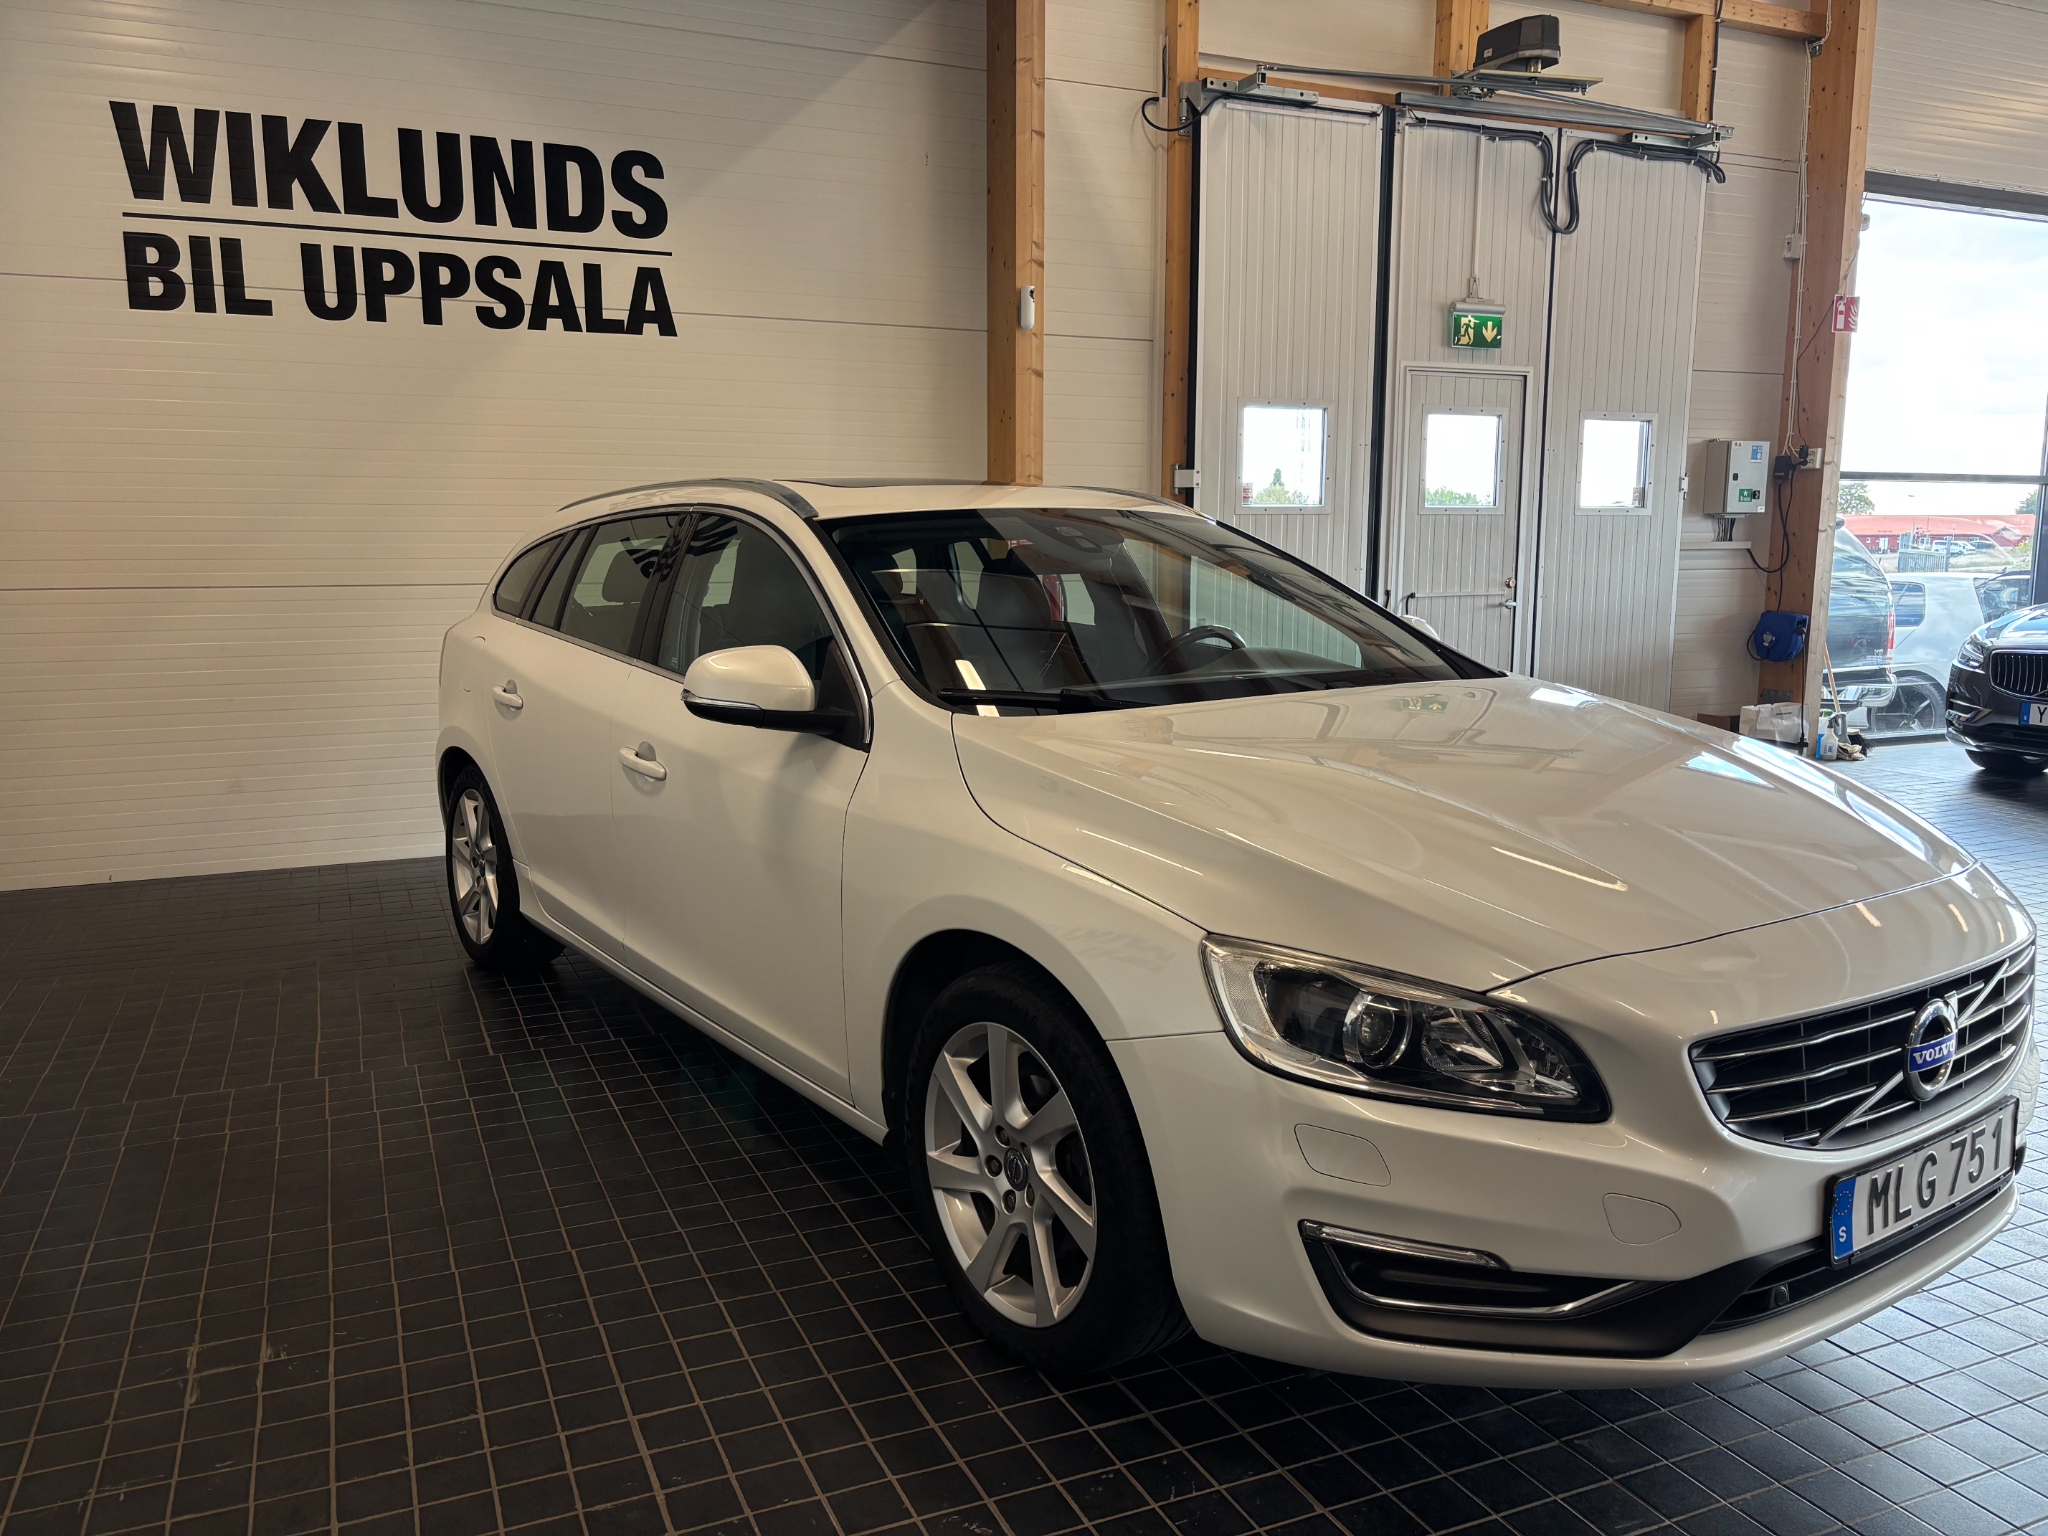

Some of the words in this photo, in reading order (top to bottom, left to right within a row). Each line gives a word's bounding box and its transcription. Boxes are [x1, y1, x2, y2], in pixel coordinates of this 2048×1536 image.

[109, 100, 669, 239] WIKLUNDS
[122, 231, 273, 316] BIL
[300, 243, 678, 337] UPPSALA
[1913, 1039, 1955, 1064] VOLVO
[1868, 1151, 1938, 1235] MLG
[1949, 1117, 2003, 1196] 751
[1838, 1226, 1847, 1242] S
